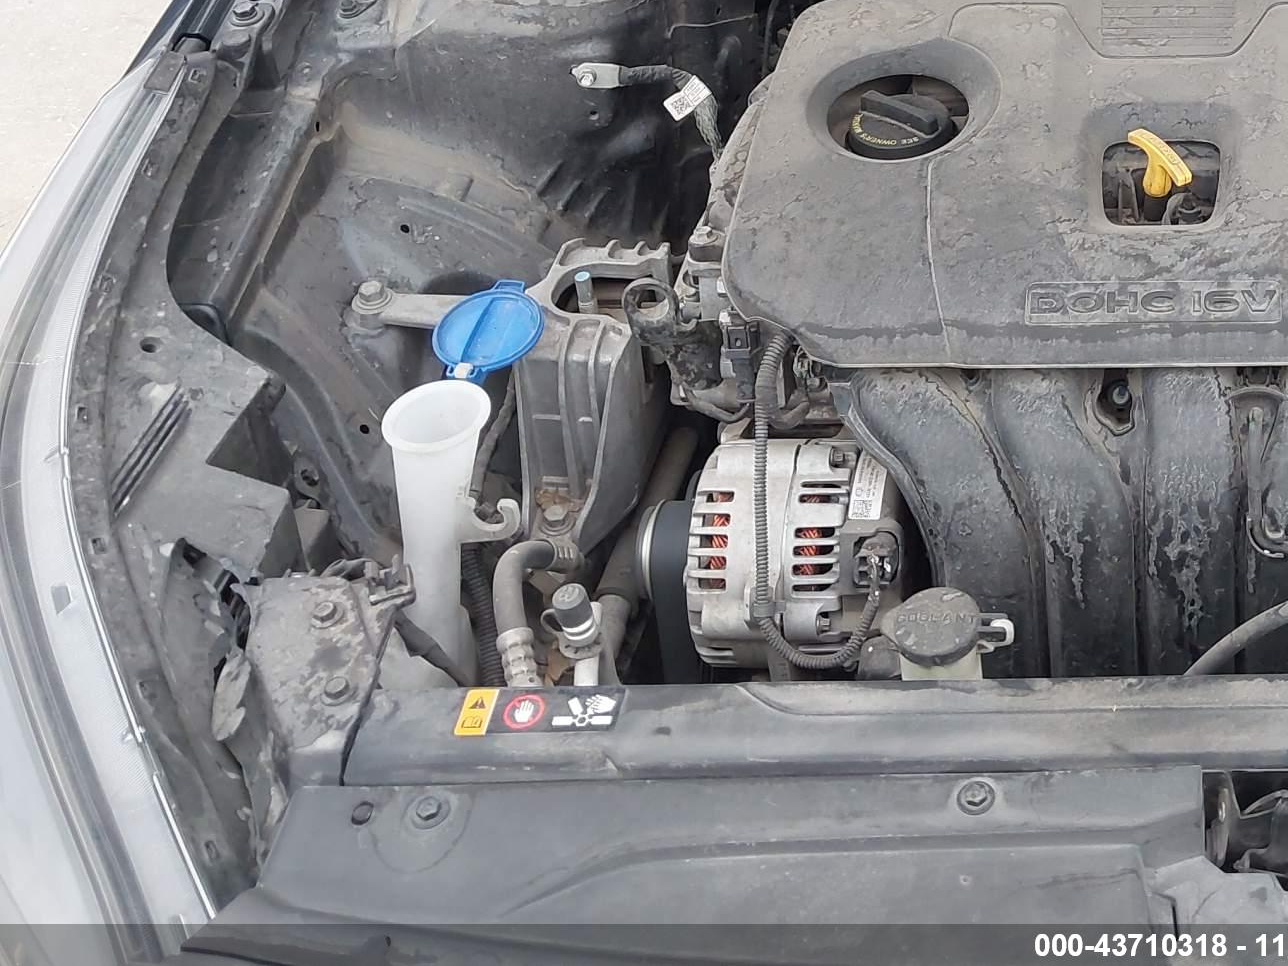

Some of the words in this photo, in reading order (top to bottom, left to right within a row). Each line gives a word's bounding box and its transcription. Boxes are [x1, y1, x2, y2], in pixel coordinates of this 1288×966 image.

[1030, 290, 1176, 315] DOHC
[1191, 289, 1277, 313] 16V
[898, 612, 976, 624] COOLANT
